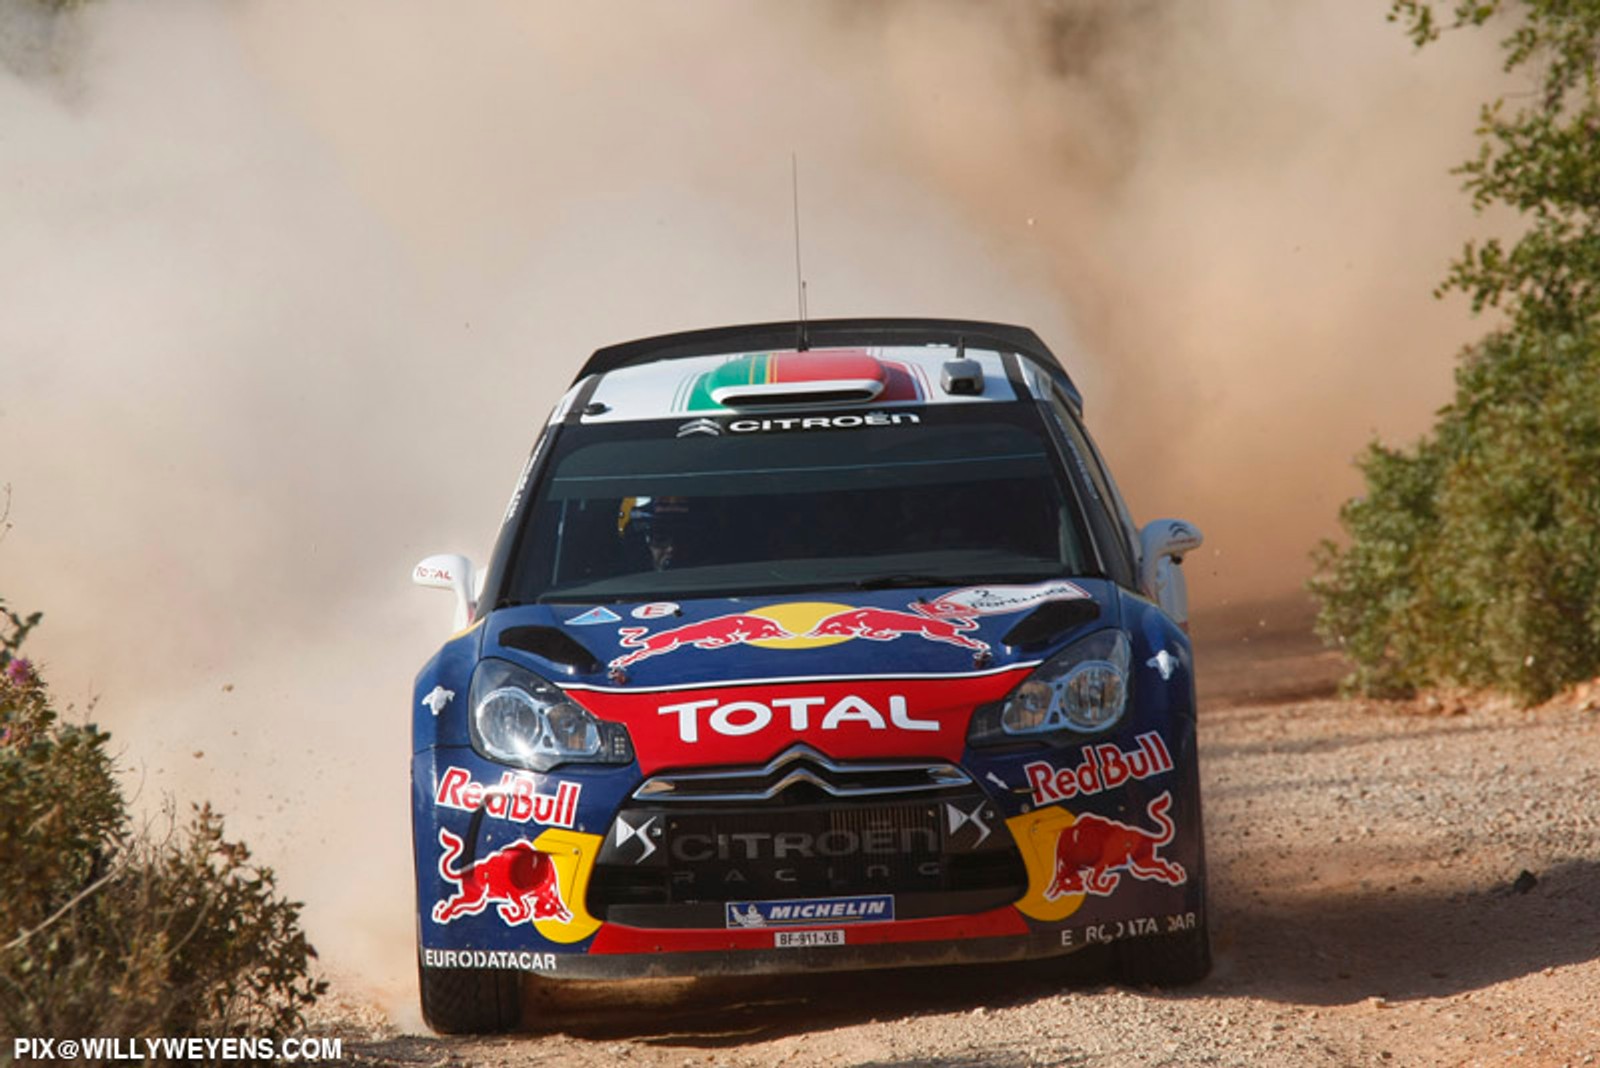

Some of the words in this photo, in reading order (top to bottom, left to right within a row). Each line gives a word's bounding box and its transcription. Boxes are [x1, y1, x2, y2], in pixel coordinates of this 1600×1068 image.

[657, 694, 941, 744] TOTAL
[768, 900, 886, 920] MICHELIN
[425, 949, 557, 971] EURODATACAR
